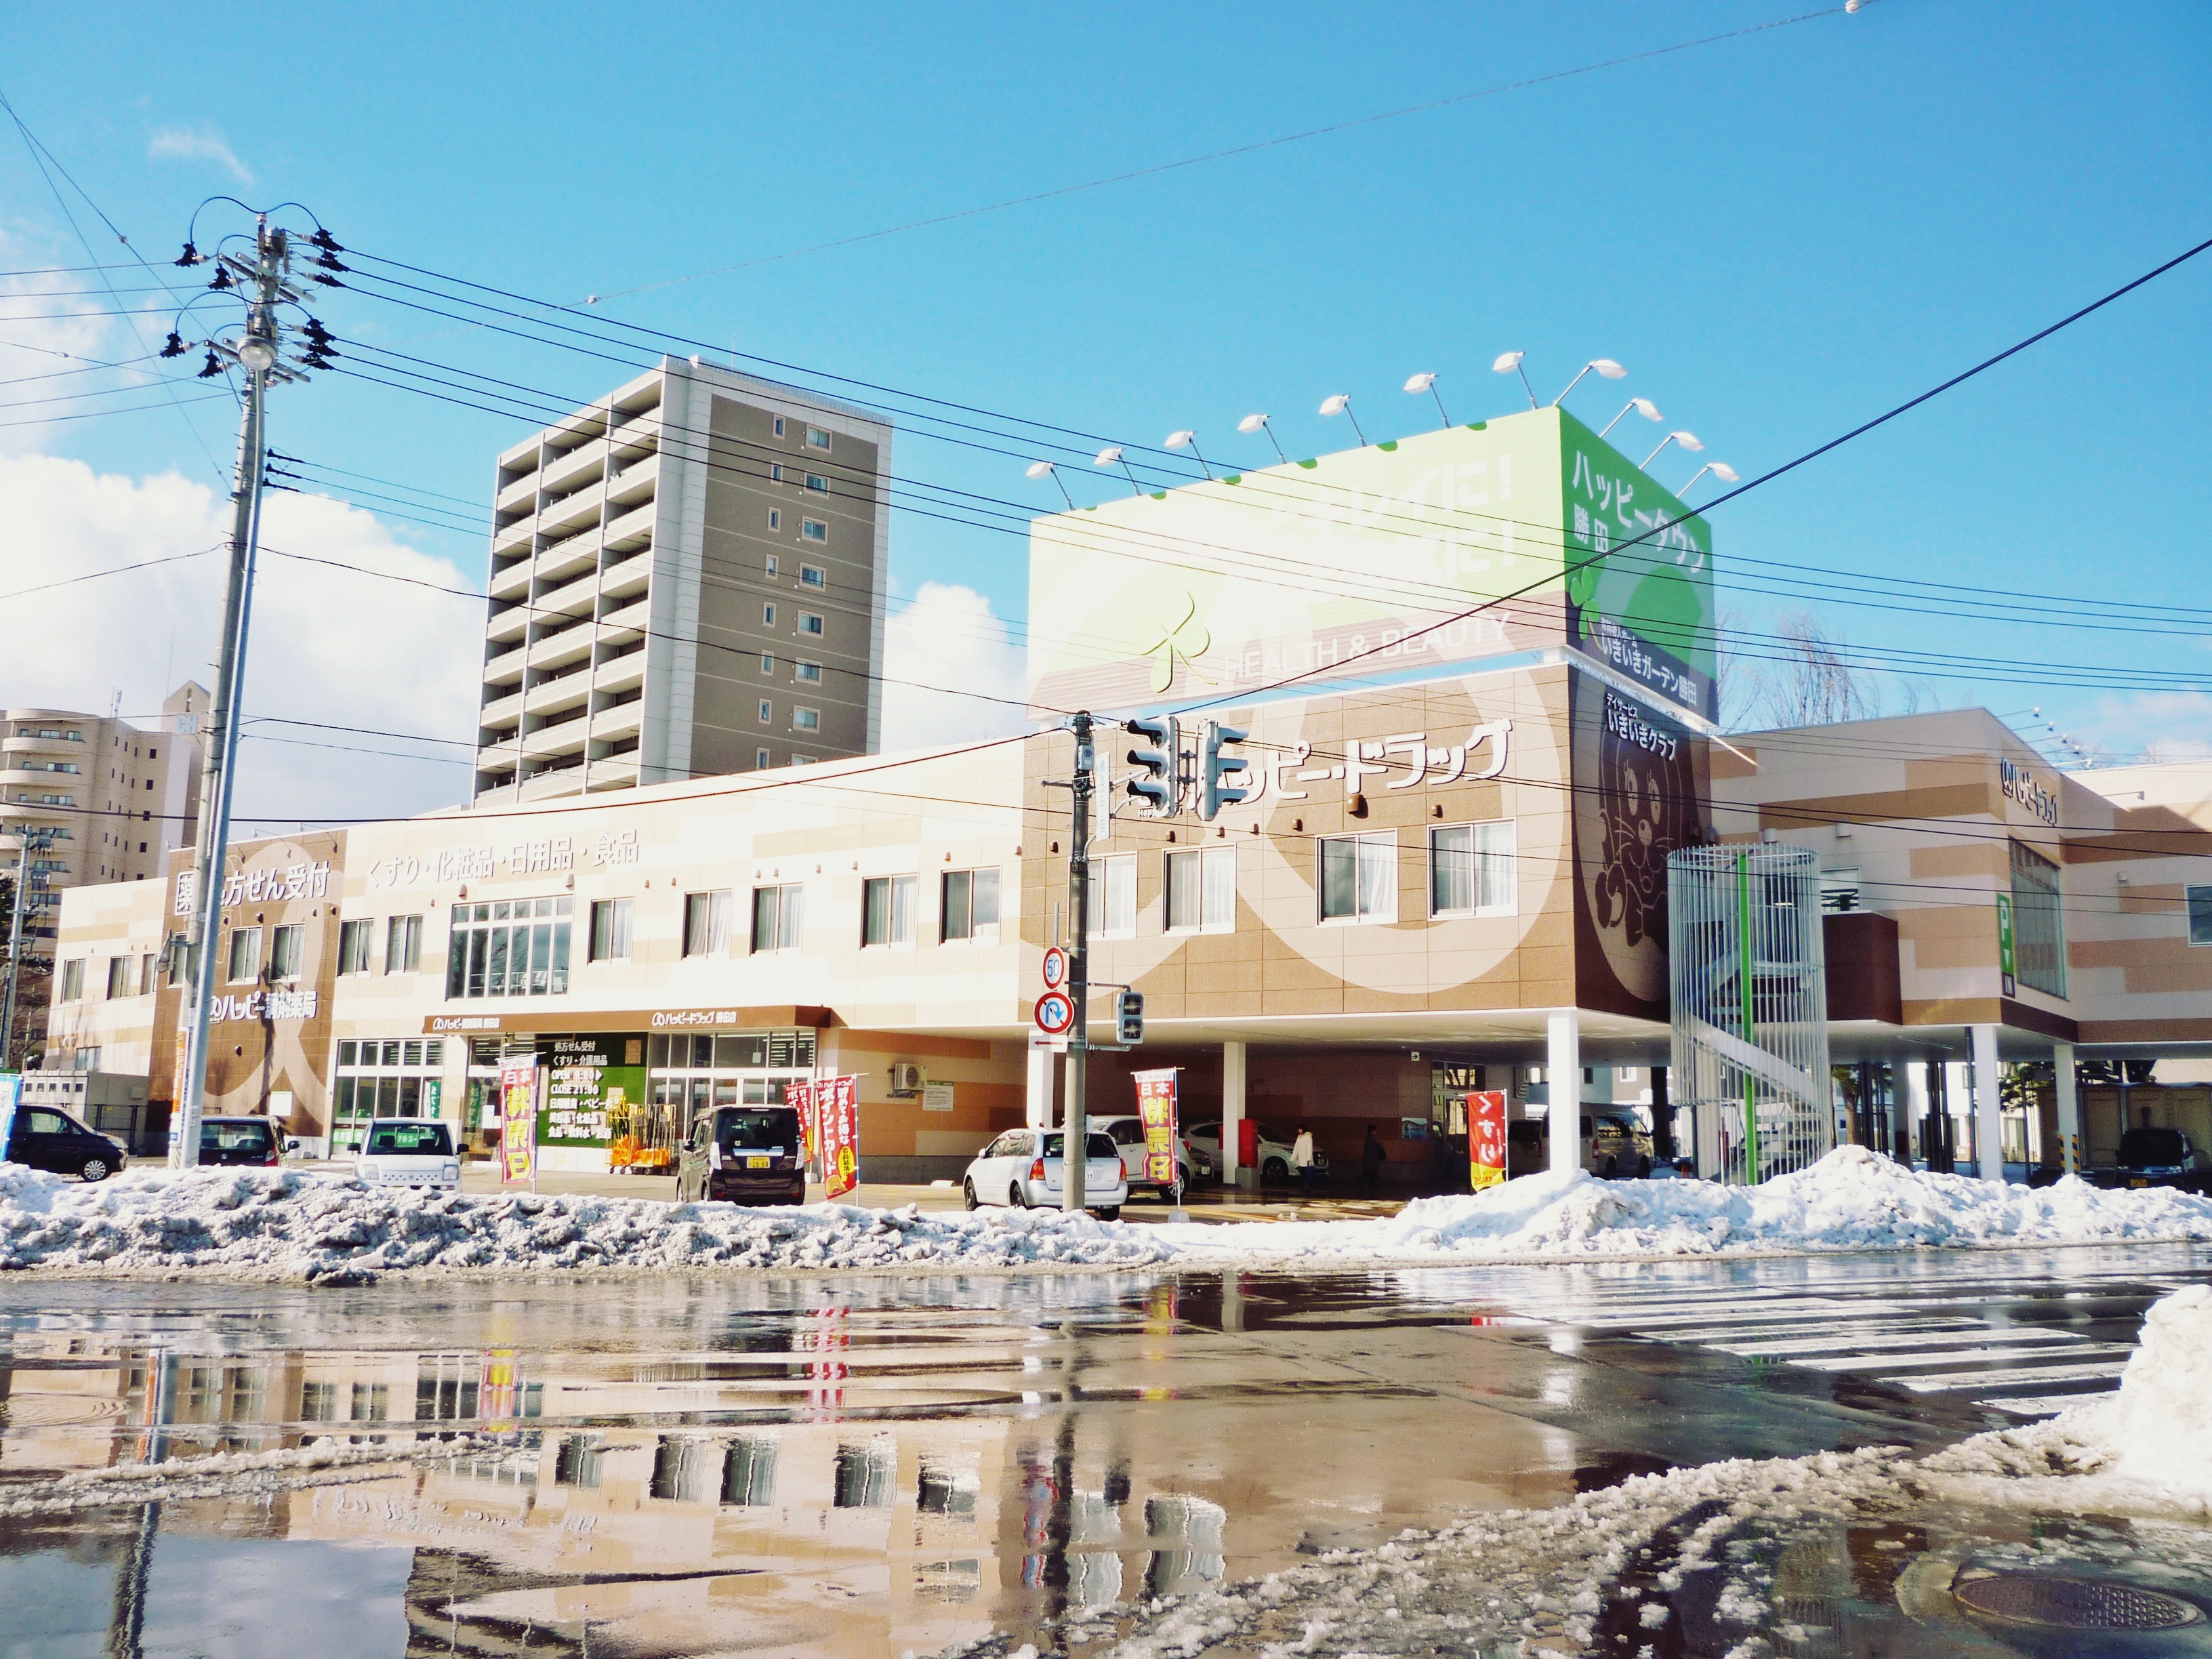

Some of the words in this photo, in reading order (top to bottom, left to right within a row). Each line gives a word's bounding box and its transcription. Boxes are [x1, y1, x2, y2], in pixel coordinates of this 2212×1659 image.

[1572, 450, 1705, 573] ハッピータウン
[1574, 504, 1609, 558] 勝田
[1225, 638, 1338, 680] HEALTH
[1349, 634, 1372, 662] &
[1382, 611, 1511, 659] BEAUTY
[1601, 632, 1697, 706] いきいきガーデン勝田
[1607, 693, 1638, 719] デイサービス
[1607, 708, 1677, 760] いきいきクラブ
[220, 861, 330, 907] 方せん受付
[1999, 900, 2009, 942] P
[1047, 959, 1059, 977] 50
[553, 1054, 608, 1066] くすり・介護用品
[554, 1040, 596, 1052] 処方せん受付
[551, 1084, 572, 1094] CLOSE
[573, 1084, 599, 1094] 21:00
[552, 1069, 570, 1080] OPEN
[819, 1087, 837, 1175] ポイントカード
[837, 1086, 851, 1145] 貯めてお得な
